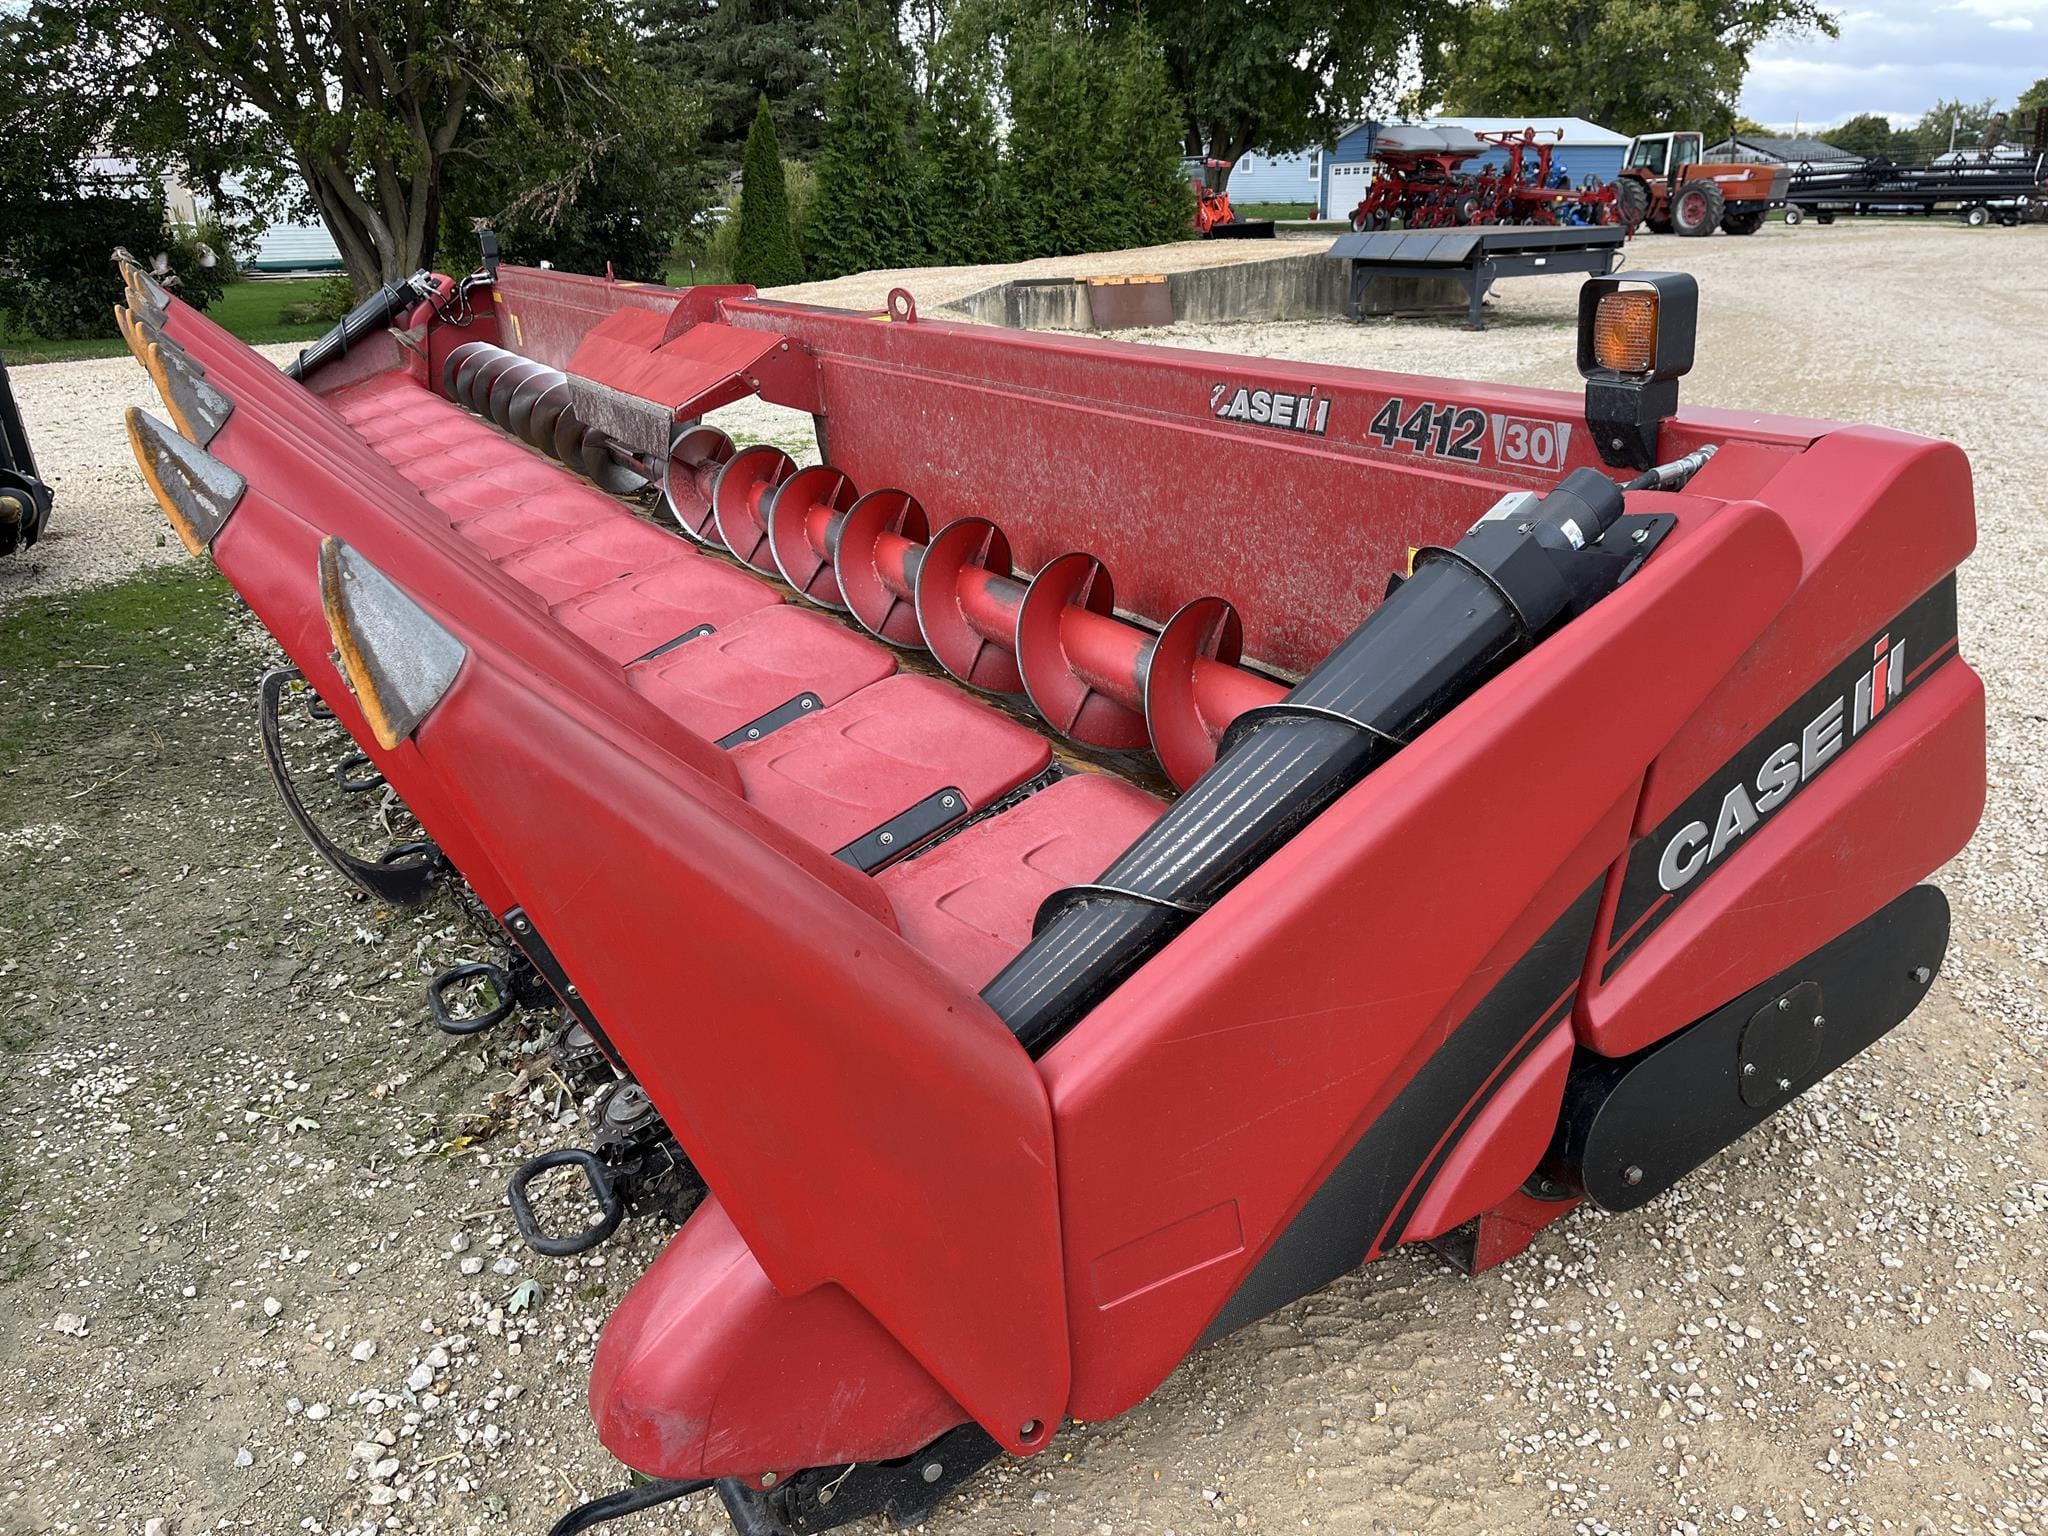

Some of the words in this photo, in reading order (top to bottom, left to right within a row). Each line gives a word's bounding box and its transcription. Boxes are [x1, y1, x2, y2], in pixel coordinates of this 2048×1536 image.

[1368, 398, 1487, 463] 4412
[1506, 424, 1554, 464] 30
[1658, 695, 1844, 891] CASE
